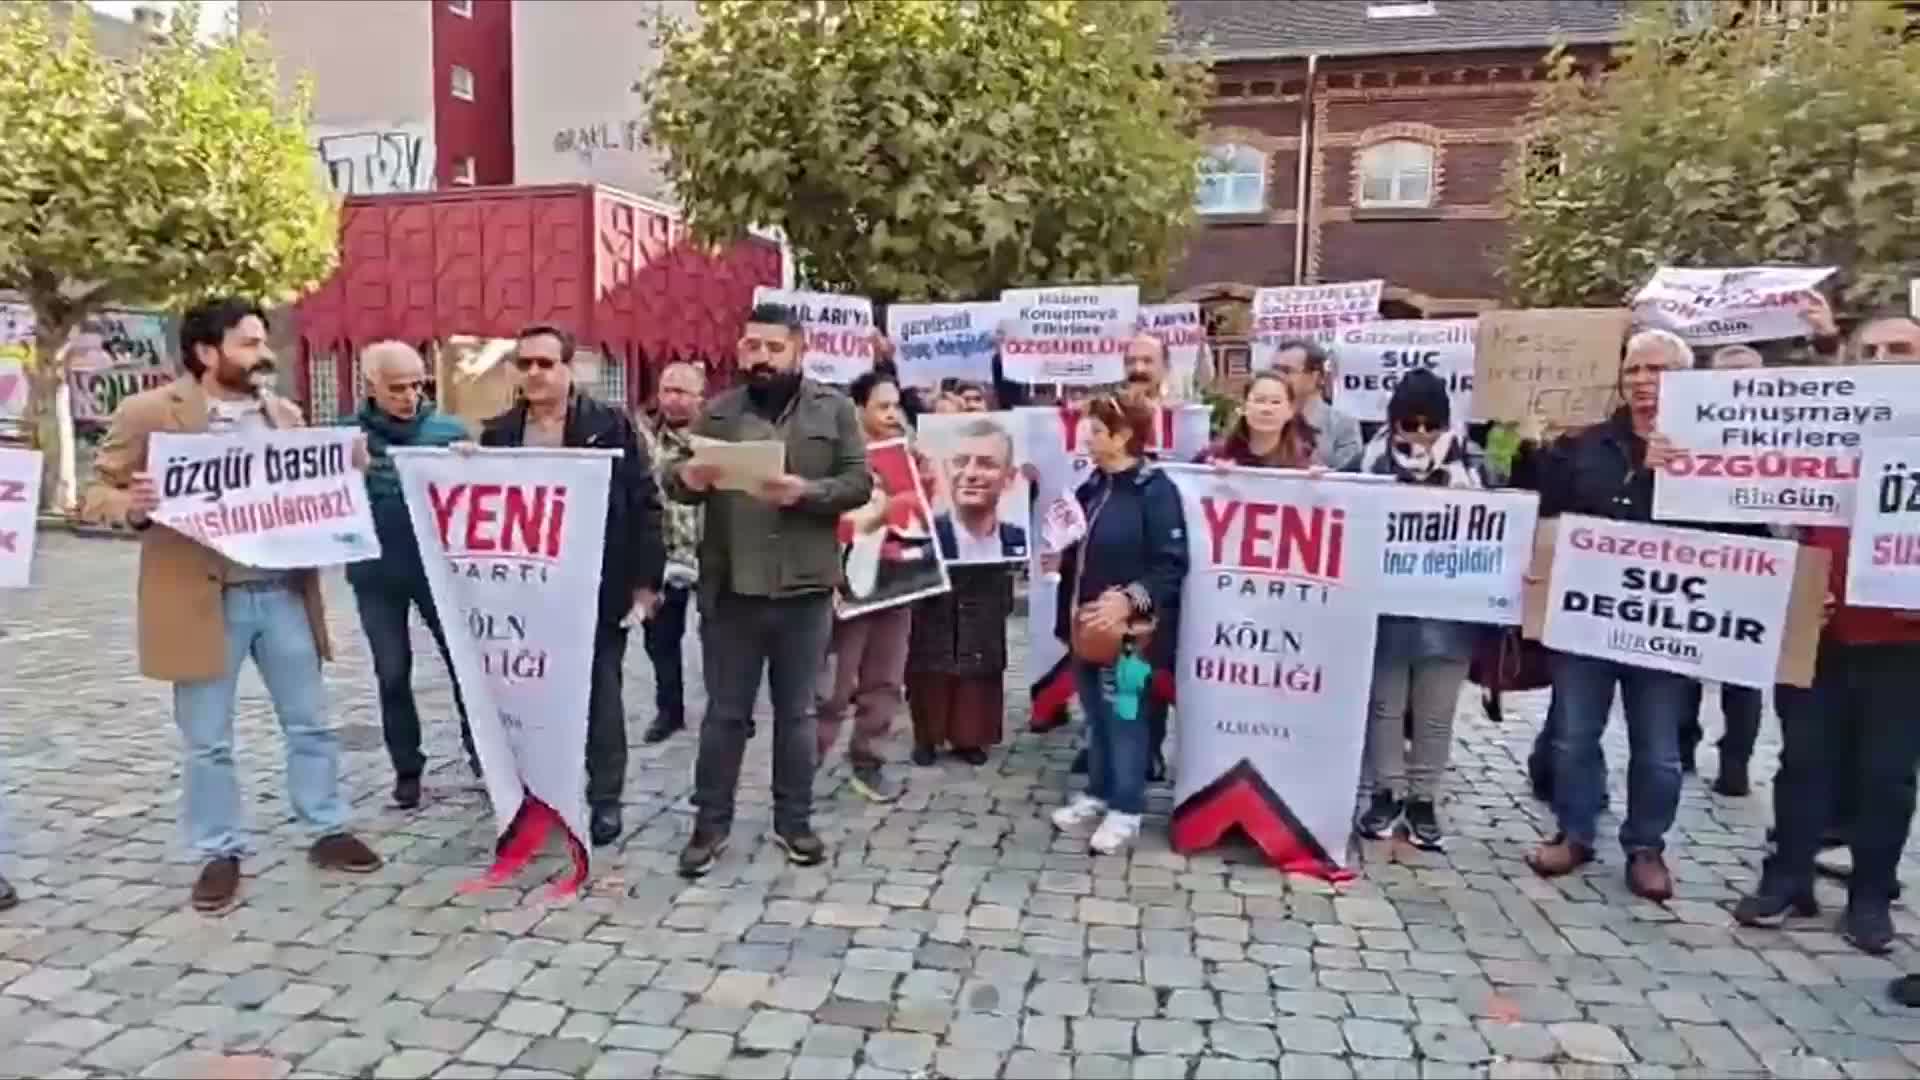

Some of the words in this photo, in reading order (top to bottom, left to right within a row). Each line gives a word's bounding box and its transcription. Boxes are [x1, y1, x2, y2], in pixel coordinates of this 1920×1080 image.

[1732, 377, 1856, 398] Habere
[1696, 404, 1893, 425] Konuşmaya
[1721, 428, 1861, 447] Fikirlere
[163, 446, 255, 502] özgür
[264, 442, 345, 488] basın
[1386, 503, 1461, 543] smail
[1569, 527, 1778, 577] Gazetecilik
[1621, 566, 1708, 601] SUÇ
[1561, 589, 1767, 644] DEĞİLDİR
[1214, 618, 1303, 654] KÖLN
